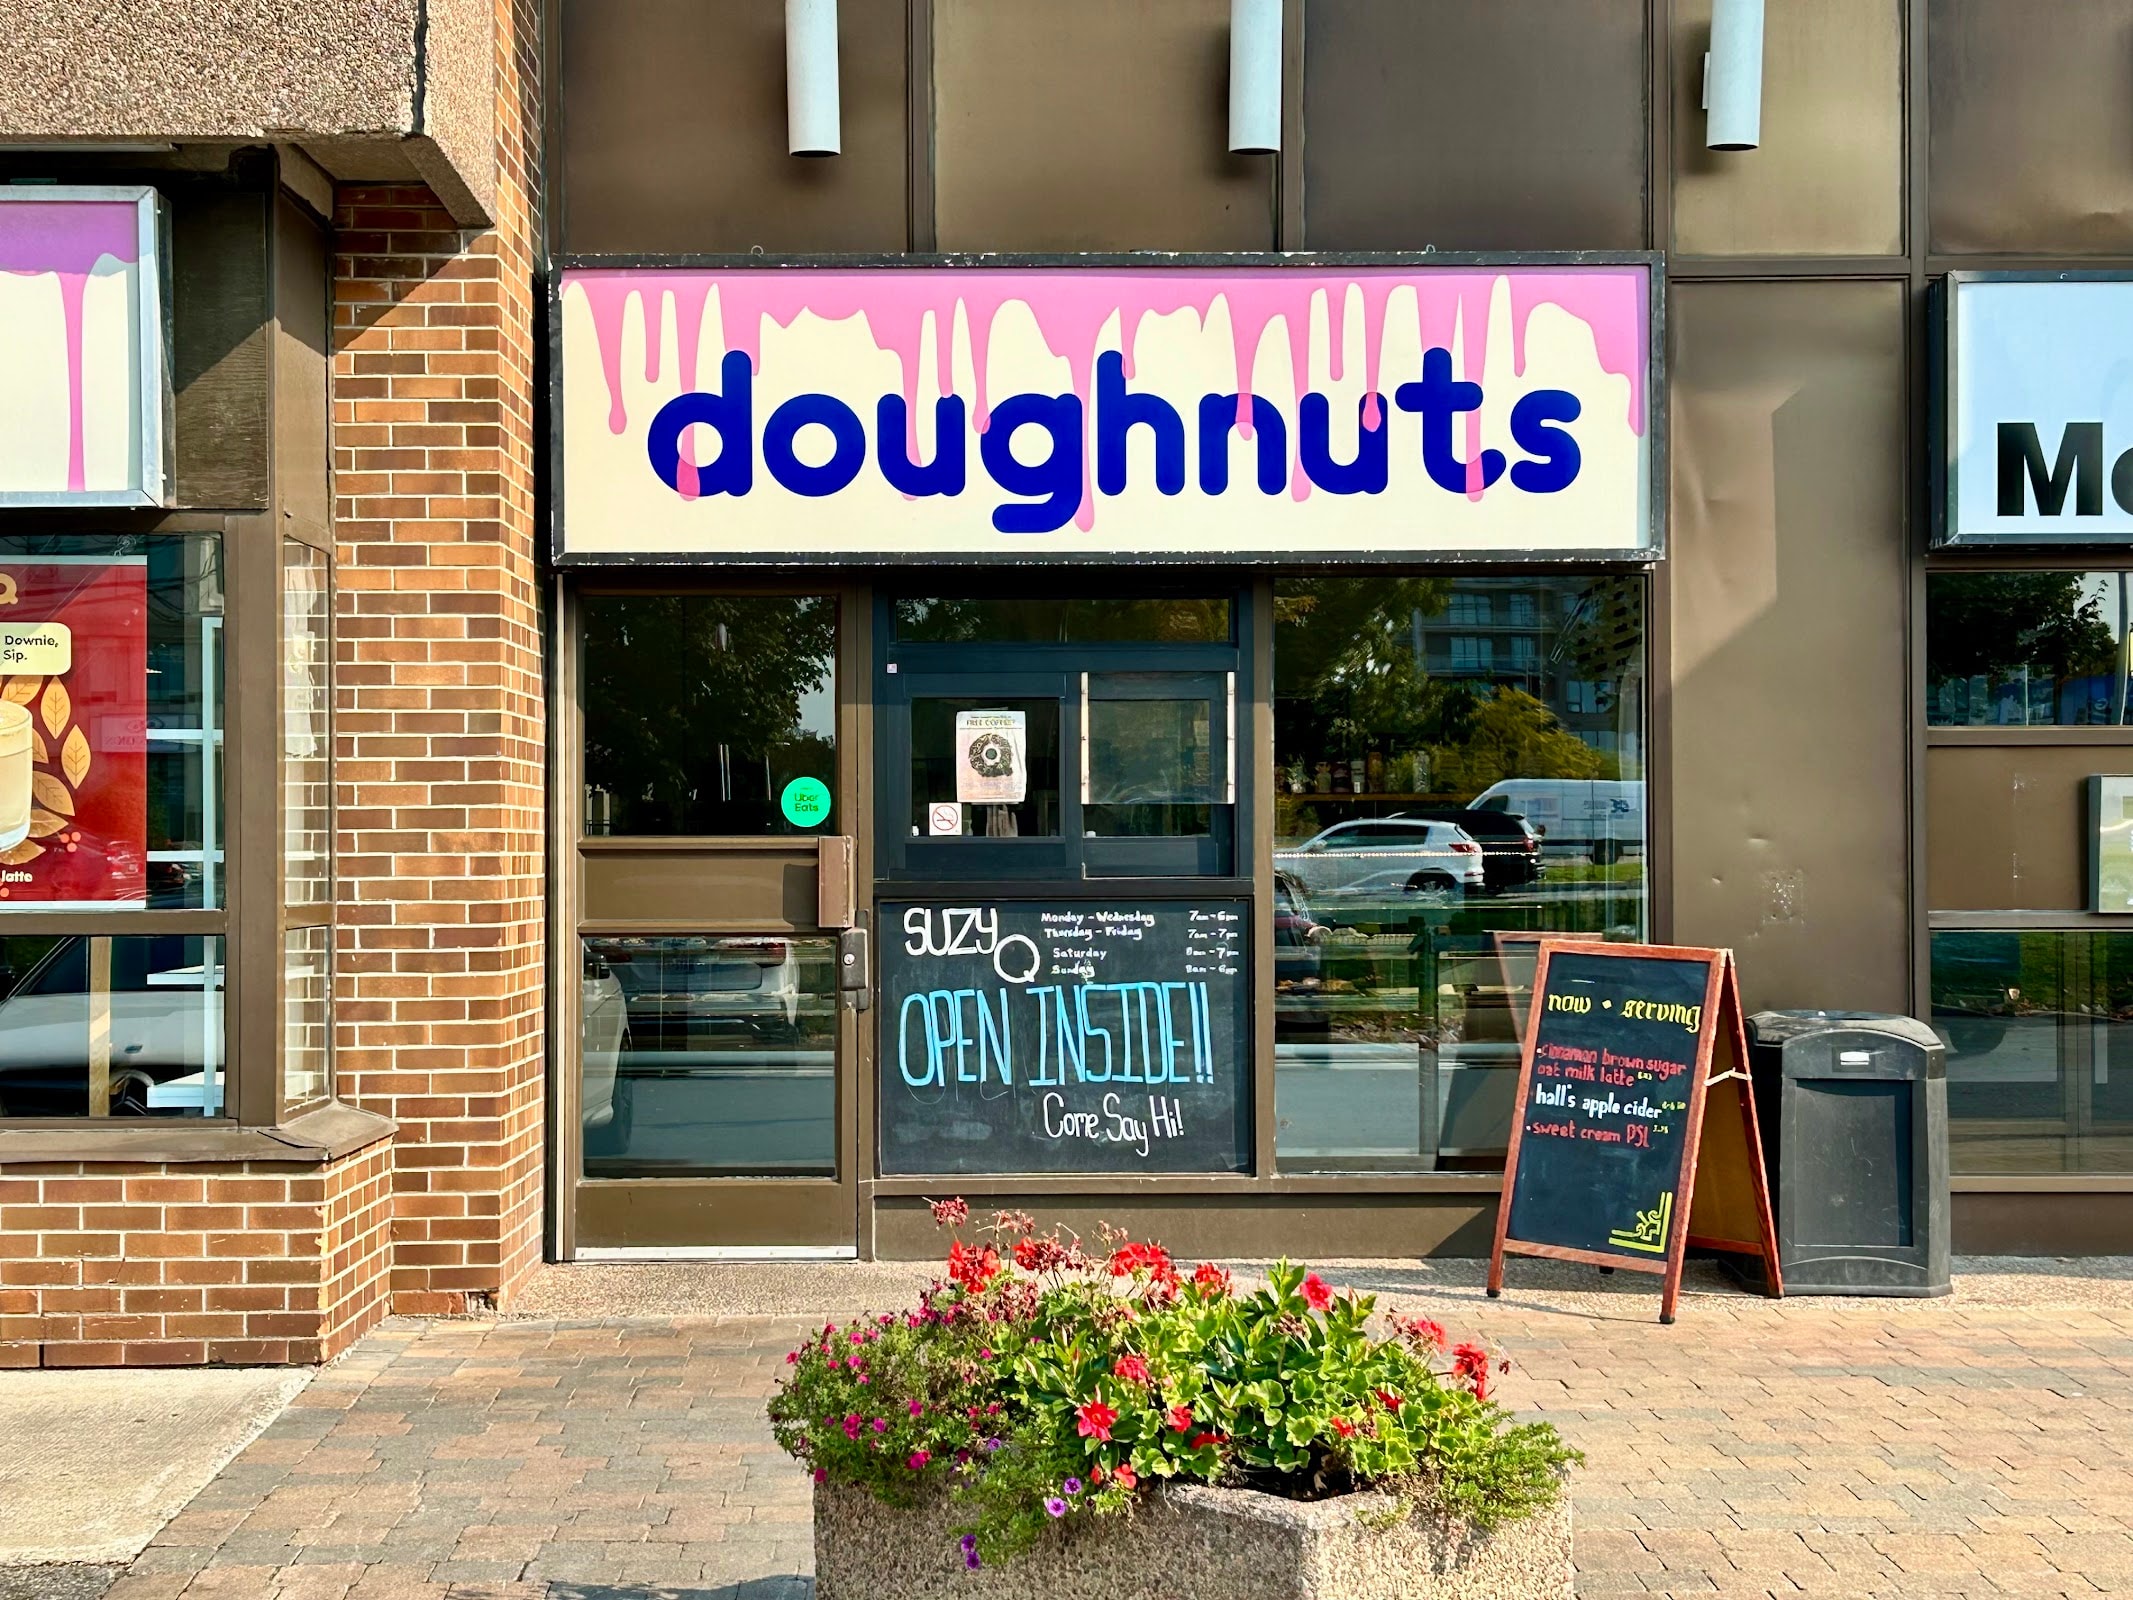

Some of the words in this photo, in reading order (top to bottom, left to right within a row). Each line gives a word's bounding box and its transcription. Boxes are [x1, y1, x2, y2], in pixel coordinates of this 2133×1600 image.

[647, 347, 1582, 534] doughnuts
[4, 635, 59, 648] Downie,
[3, 649, 28, 663] Sip.
[794, 792, 819, 802] Uber
[794, 803, 819, 812] Eats
[1, 869, 33, 883] latte
[1041, 911, 1085, 926] Monday
[903, 907, 998, 956] SUZY
[1044, 926, 1093, 941] Thursday
[1105, 925, 1142, 940] Friday
[993, 934, 1040, 983] Q
[1053, 947, 1107, 960] Saturday
[1051, 961, 1096, 978] Sunday
[1548, 994, 1592, 1014] now
[1619, 999, 1701, 1034] serving
[899, 987, 1012, 1086] OPEN
[1026, 981, 1215, 1086] INSIDE!!
[1537, 1062, 1561, 1077] oat
[1565, 1063, 1596, 1082] milk
[1600, 1066, 1635, 1087] latte
[1601, 1047, 1645, 1071] brown
[1646, 1058, 1688, 1081] sugar
[1535, 1082, 1576, 1108] hall's
[1582, 1091, 1620, 1119] apple
[1623, 1096, 1663, 1119] cider
[1043, 1092, 1100, 1139] Come
[1103, 1092, 1149, 1157] Say
[1150, 1095, 1185, 1139] Hi!
[1532, 1119, 1577, 1139] sweet
[1580, 1127, 1622, 1143] cream
[1626, 1123, 1650, 1149] PSL
